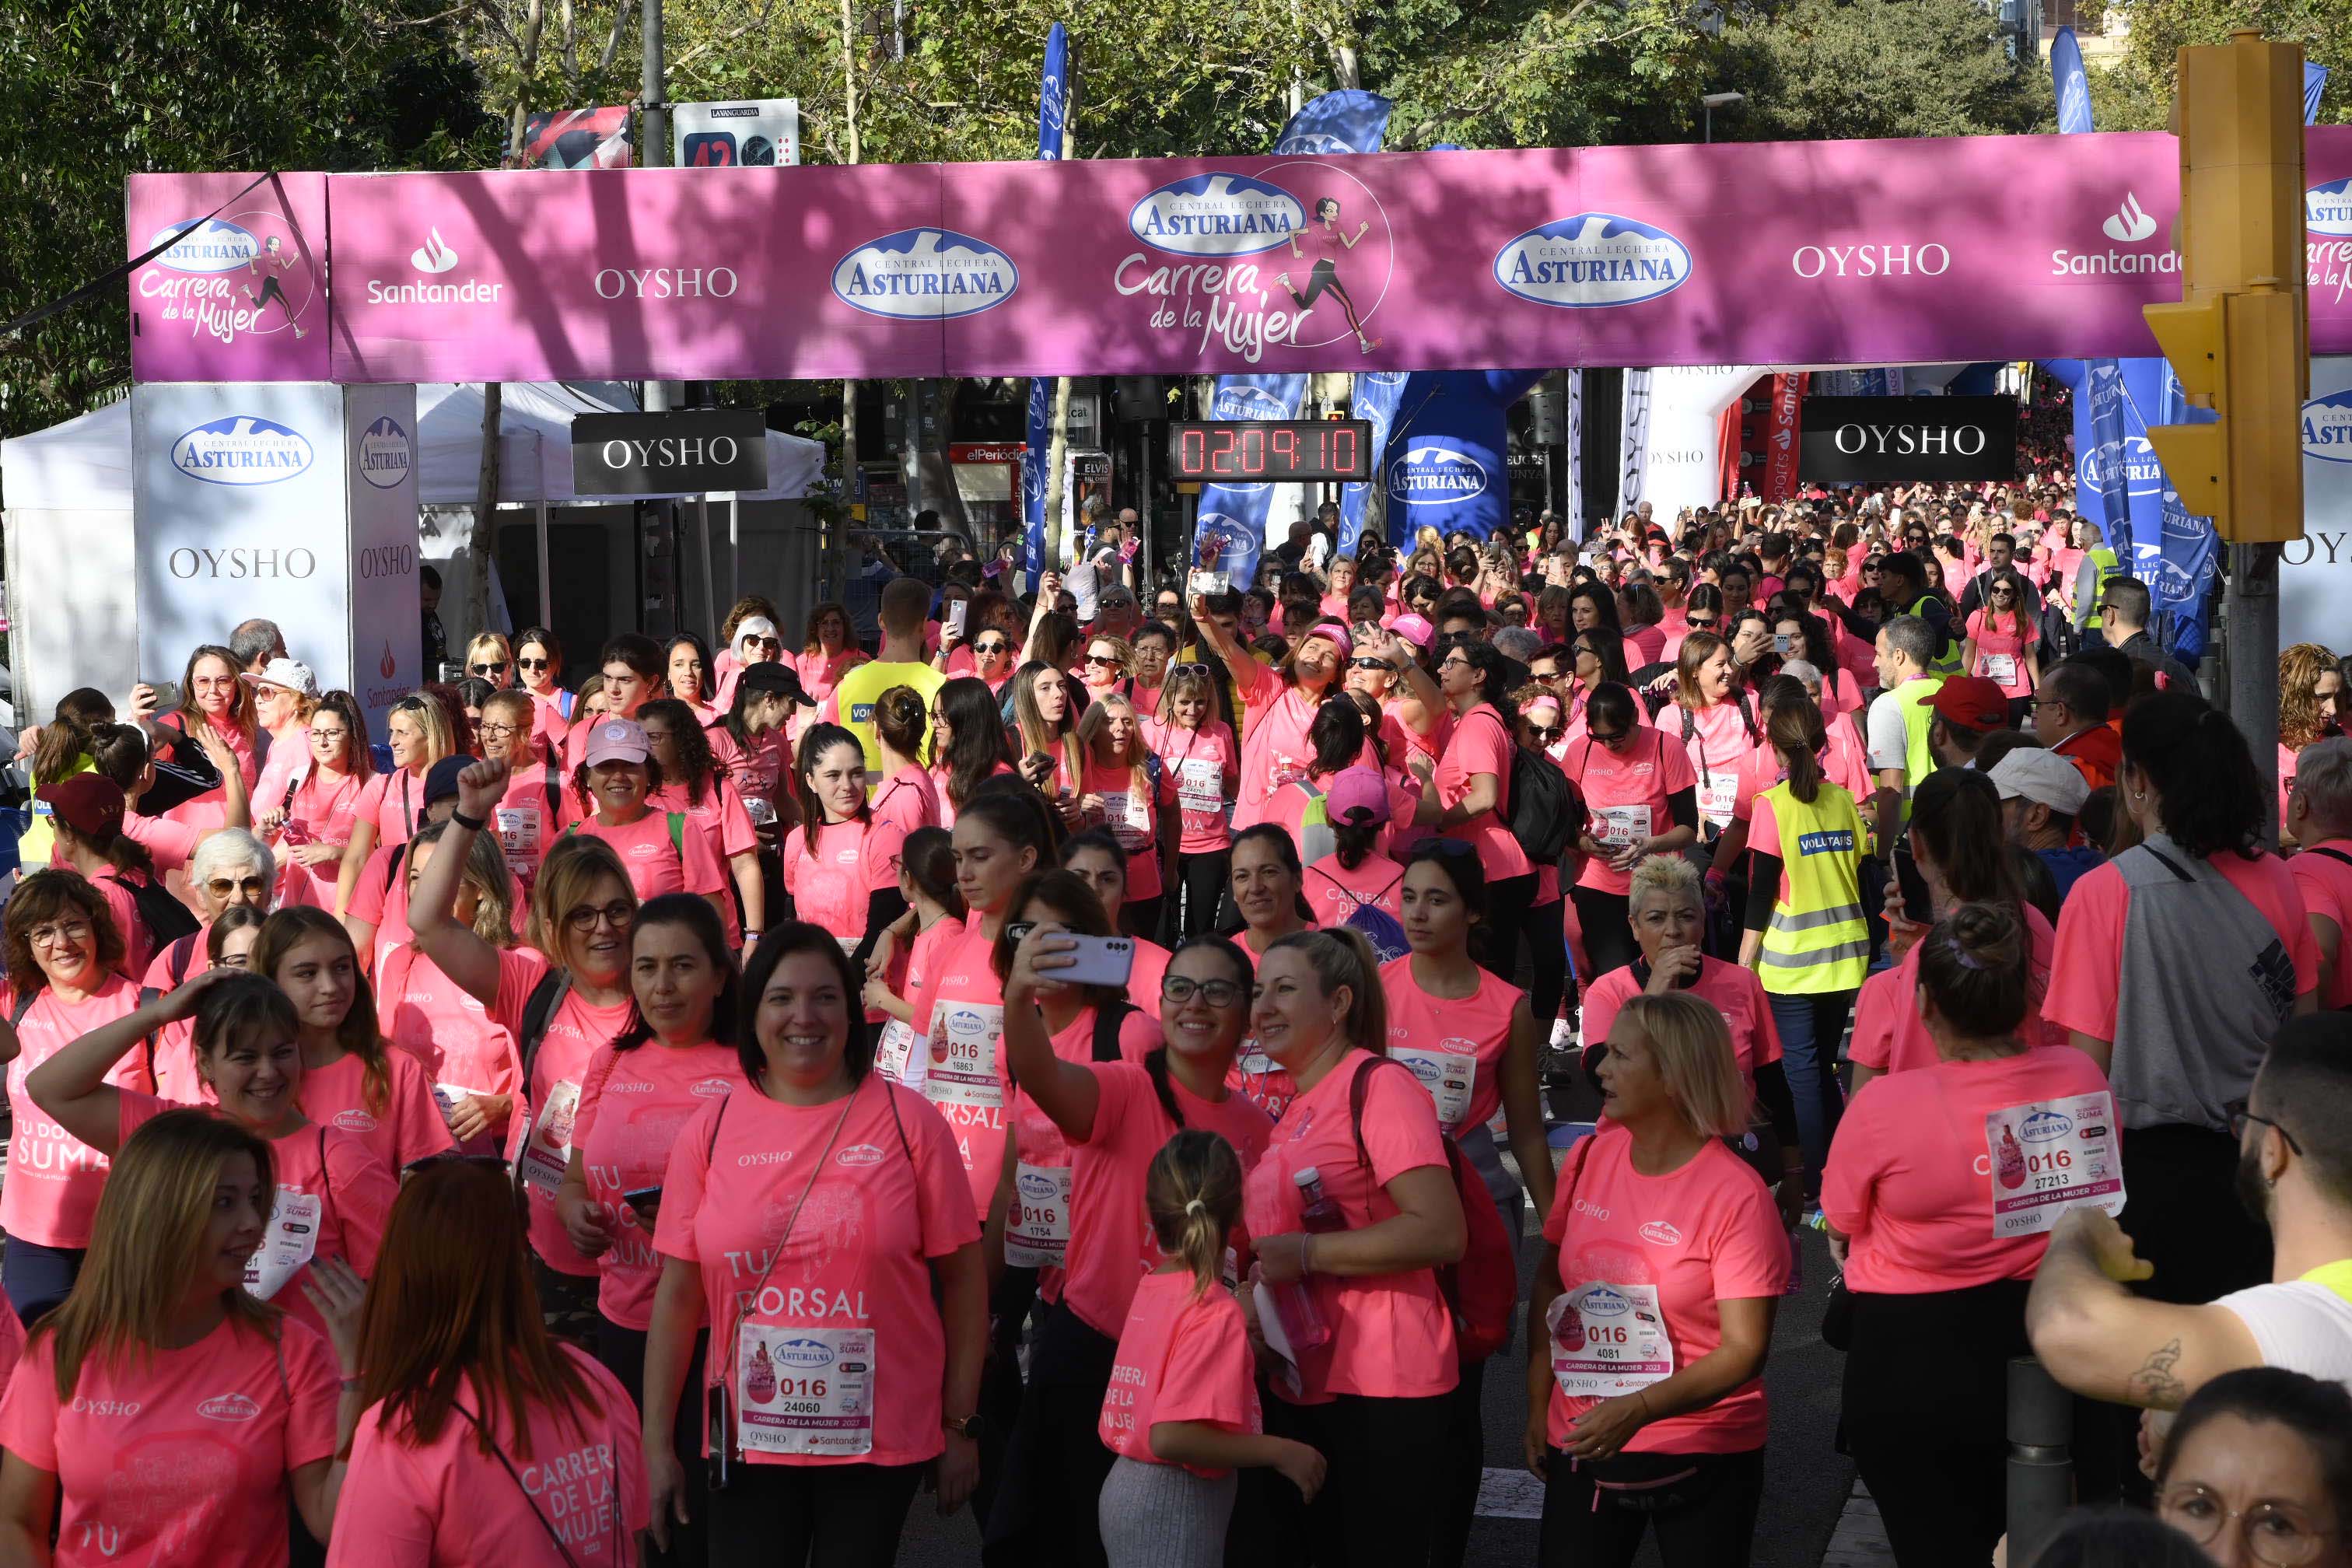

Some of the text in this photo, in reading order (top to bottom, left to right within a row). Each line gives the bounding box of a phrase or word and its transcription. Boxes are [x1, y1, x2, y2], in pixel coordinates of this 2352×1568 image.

[1170, 200, 1287, 211] CENTRAL LECHERA
[1143, 205, 1292, 236] ASTURIANA
[1539, 244, 1669, 256] CENTRAL LECHERA
[874, 258, 997, 269] CENTRAL LECHERA
[1509, 250, 1676, 284] ASTURIANA
[1793, 242, 1951, 279] OYSHO
[2053, 248, 2183, 276] Santand
[594, 266, 738, 299] OYSHO
[846, 262, 1004, 296] ASTURIANA
[1114, 253, 1260, 296] Carrera
[138, 269, 230, 299] Carrera
[367, 278, 503, 305] Santander
[162, 295, 266, 344] de la Mujer
[1150, 291, 1314, 364] de la Mujer
[1836, 423, 1985, 456] OYSHO
[183, 442, 303, 468] ASTURIANA
[362, 443, 408, 471] ASTURIANA
[603, 436, 737, 468] OYSHO
[1084, 464, 1108, 474] ELVIS
[1392, 471, 1480, 492] ASTURIANA
[169, 548, 317, 579] OYSHO
[360, 544, 412, 580] OYSHO
[1186, 779, 1205, 788] 016
[1108, 814, 1129, 822] 016
[499, 831, 517, 840] 16
[1610, 827, 1629, 836] 016
[1326, 888, 1393, 908] CARRERA
[950, 1042, 978, 1059] 016
[933, 1071, 953, 1080] CARRERA
[952, 1060, 974, 1073] 16863
[2077, 1111, 2103, 1121] SUMA
[2022, 1123, 2068, 1139] ASTURIANA
[737, 1151, 793, 1167] OYSHO
[2028, 1150, 2072, 1173] 016
[529, 1166, 562, 1185] OYSHO
[590, 1166, 621, 1190] TU
[2035, 1174, 2070, 1189] 27213
[2007, 1196, 2039, 1209] CARRERA
[2050, 1192, 2061, 1201] LA
[2062, 1188, 2090, 1199] MUJER
[285, 1207, 312, 1218] SUMA
[1024, 1206, 1055, 1223] 016
[2004, 1213, 2042, 1229] OYSHO
[1030, 1227, 1051, 1237] 1754
[1642, 1225, 1678, 1243] ASTURIANA
[723, 1251, 769, 1279] TU
[736, 1286, 870, 1321] DORSAL
[1583, 1298, 1627, 1311] ASTURIANA
[1588, 1326, 1628, 1343] 016
[779, 1349, 830, 1362] ASTURIANA
[1597, 1348, 1620, 1360] 4081
[1566, 1362, 1597, 1371] CARRERA
[780, 1378, 827, 1397] 016
[1562, 1378, 1598, 1388] OYSHO
[72, 1396, 142, 1416] OYSHO
[784, 1401, 821, 1414] 24060
[753, 1415, 785, 1425] CARRERA
[786, 1418, 798, 1426] DE
[750, 1430, 786, 1444] OYSHO
[821, 1436, 862, 1446] Santander
[550, 1478, 616, 1518] DE LA
[74, 1520, 118, 1556] TU
